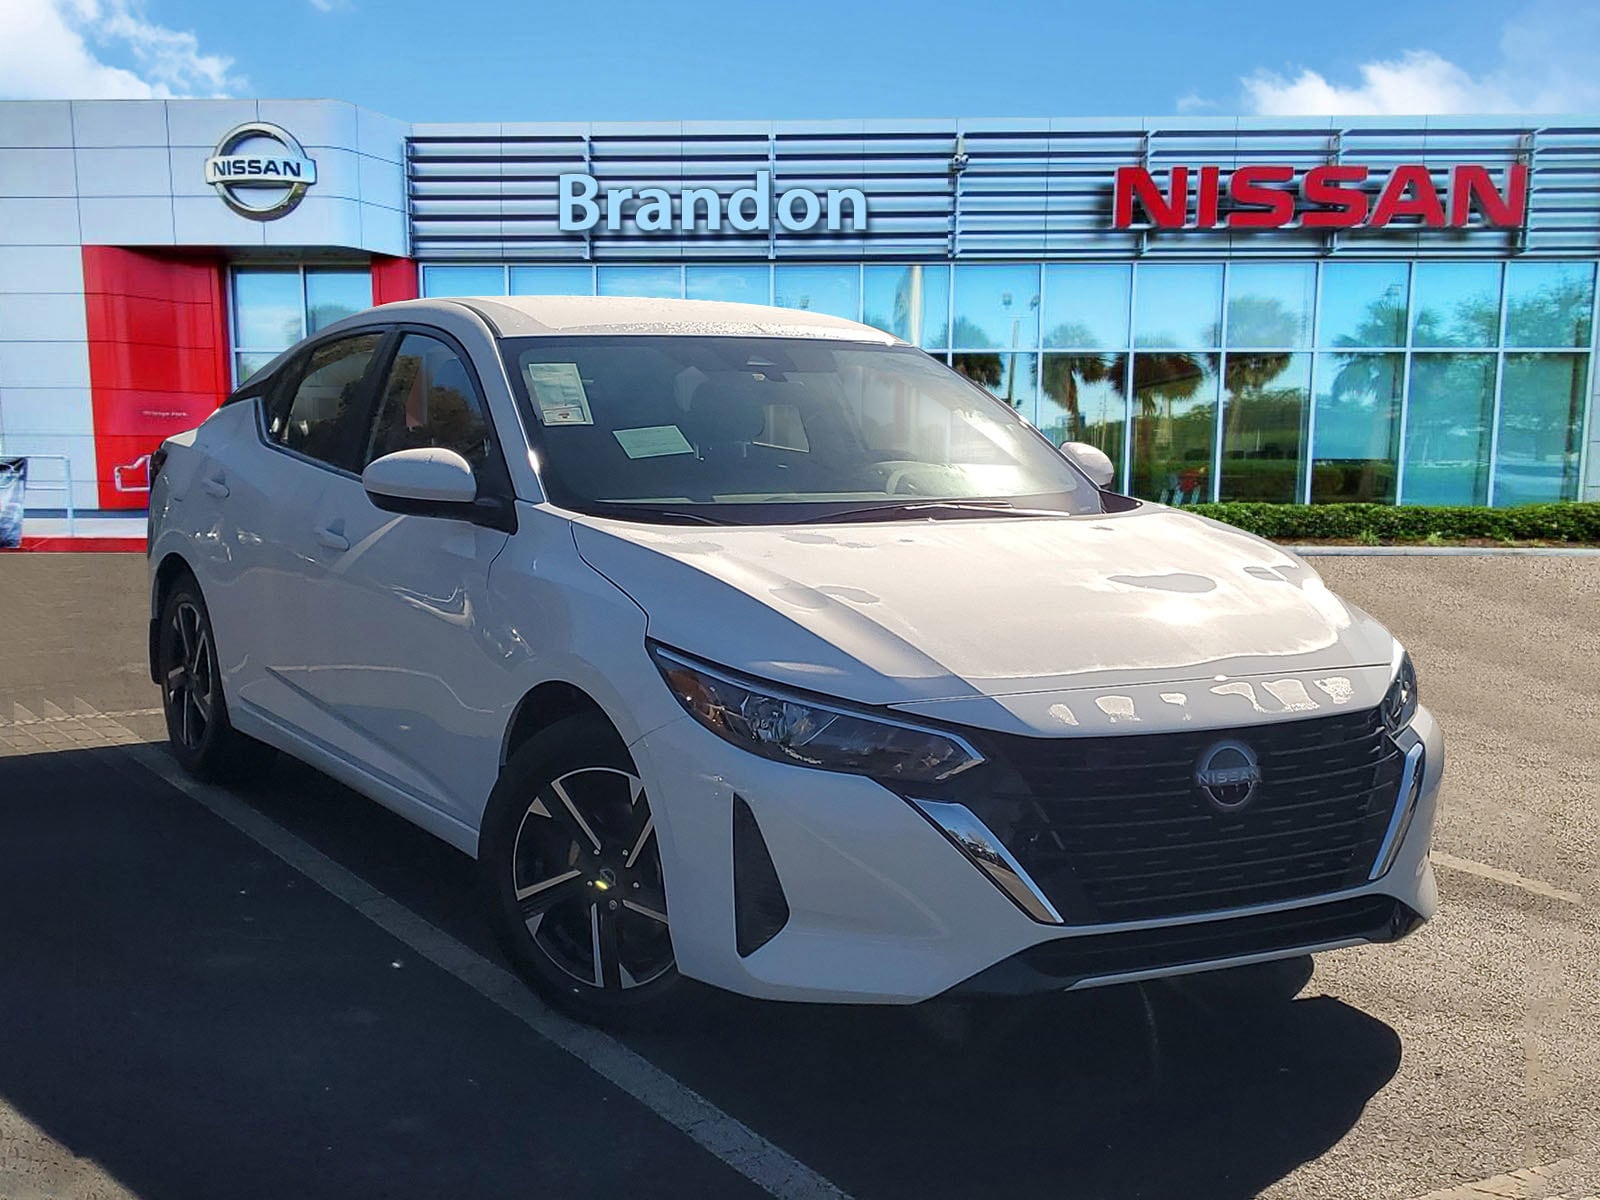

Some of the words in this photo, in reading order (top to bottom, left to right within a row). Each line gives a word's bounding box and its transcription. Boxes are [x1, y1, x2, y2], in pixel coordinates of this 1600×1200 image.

[213, 159, 301, 177] NISSAN
[559, 170, 867, 231] Brandon
[1112, 164, 1529, 229] NISSAN
[1197, 767, 1259, 785] NISSAN
